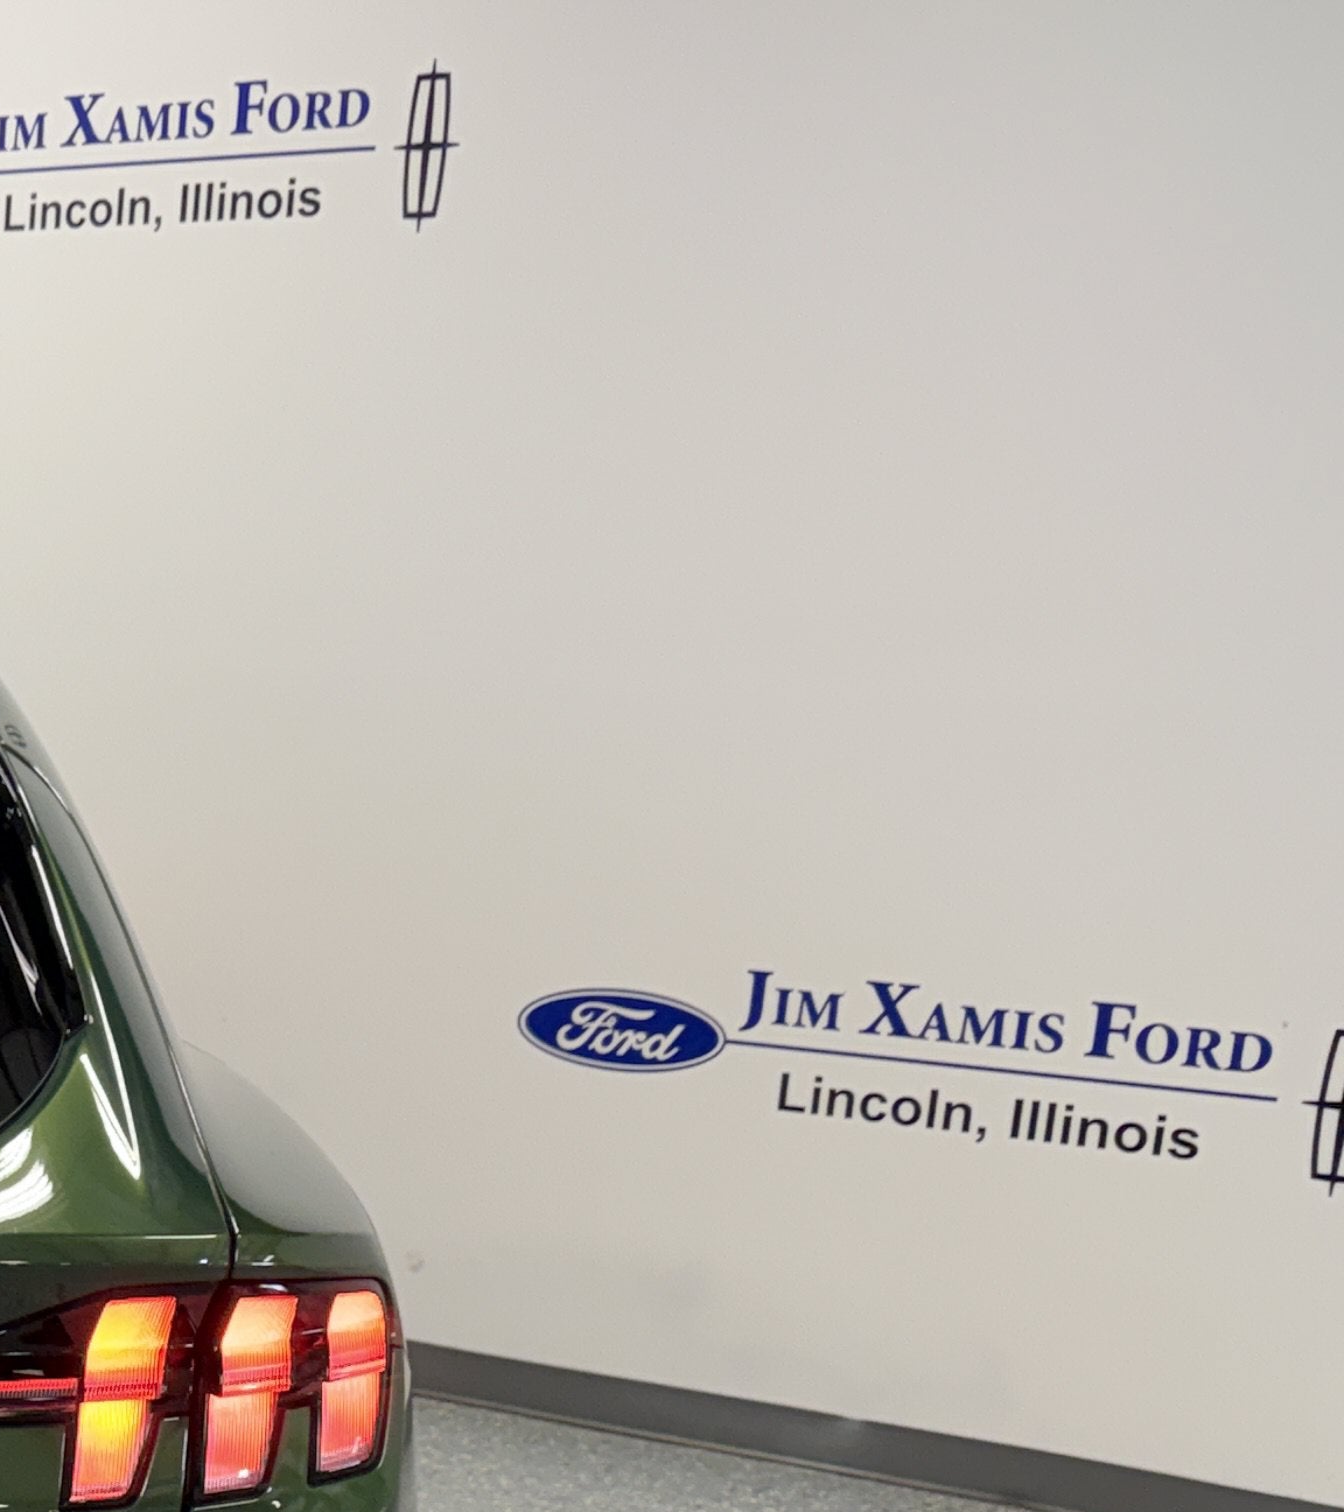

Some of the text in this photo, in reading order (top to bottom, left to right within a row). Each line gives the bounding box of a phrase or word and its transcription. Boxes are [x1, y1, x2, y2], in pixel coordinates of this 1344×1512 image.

[61, 93, 215, 147] XAMIS
[230, 79, 371, 136] FORD
[4, 177, 321, 232] Lincoln, Illinois
[554, 1005, 685, 1064] Ford
[738, 969, 1273, 1073] JIM XAMIS FORD
[777, 1072, 1199, 1161] Lincoln, Illinois
